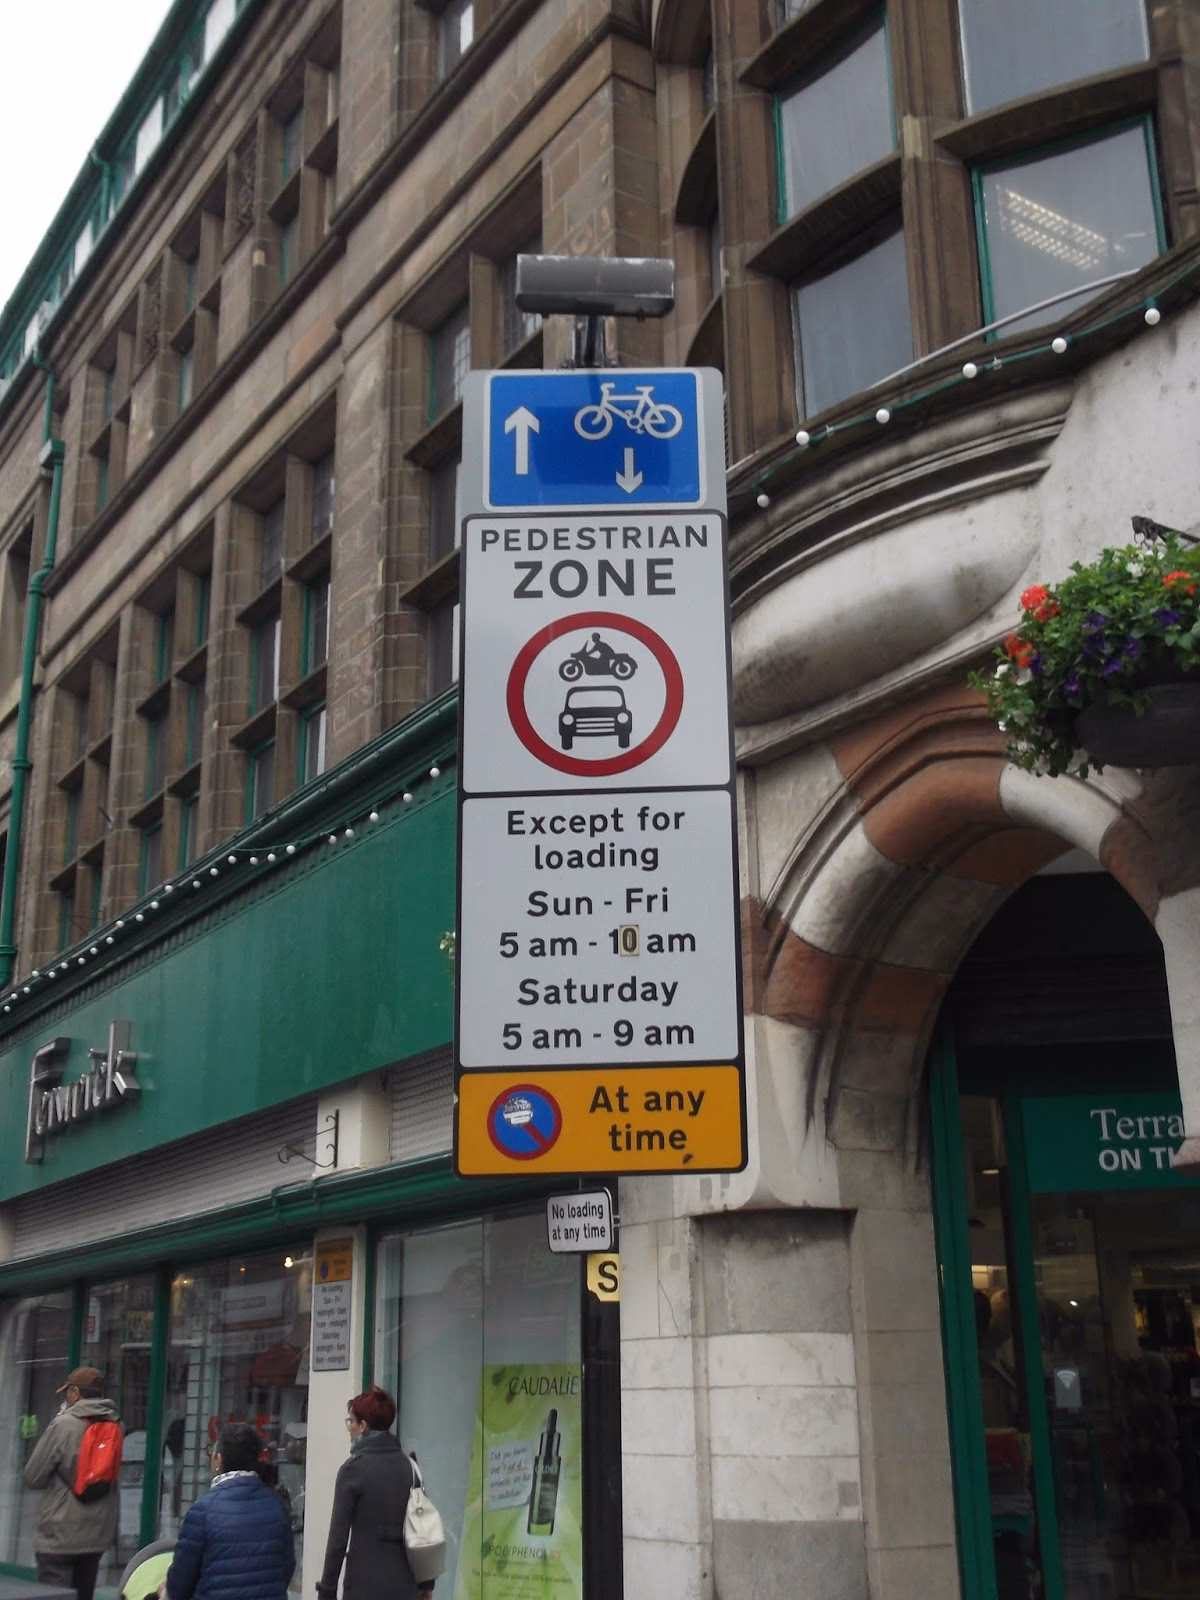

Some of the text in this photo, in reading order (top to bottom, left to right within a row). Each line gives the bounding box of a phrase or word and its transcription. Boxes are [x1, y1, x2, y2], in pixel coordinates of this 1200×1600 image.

[481, 525, 708, 552] PEDESTRIAN
[513, 558, 676, 599] ZONE
[507, 806, 685, 837] Except for
[534, 842, 659, 871] loading
[526, 890, 593, 917] Sun
[625, 887, 669, 913] Fri
[517, 975, 679, 1007] Saturday
[589, 1085, 705, 1117] At any
[608, 1123, 688, 1152] time
[1098, 1148, 1142, 1172] ON
[551, 1201, 604, 1220] No loading
[552, 1222, 606, 1243] at any time
[597, 1260, 618, 1293] S
